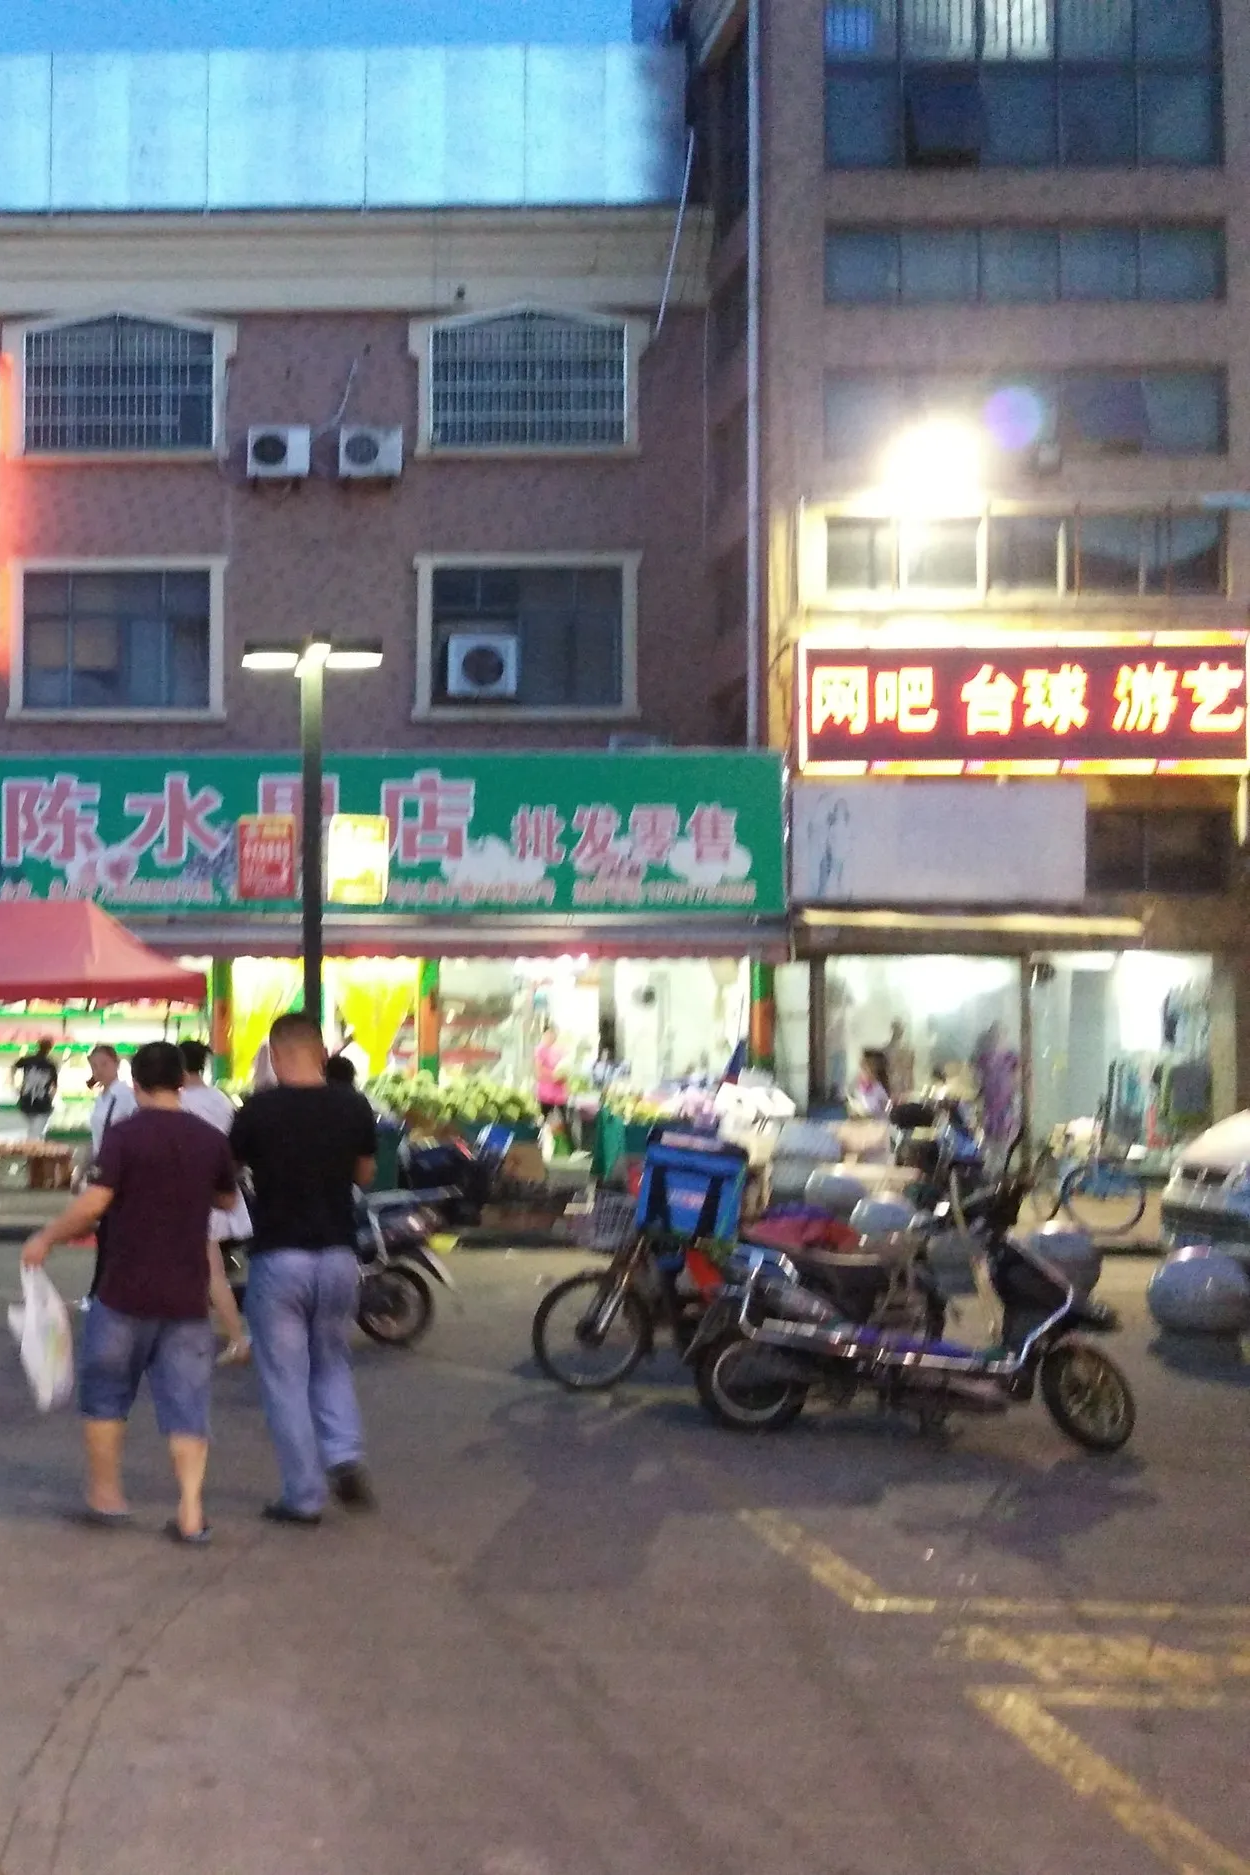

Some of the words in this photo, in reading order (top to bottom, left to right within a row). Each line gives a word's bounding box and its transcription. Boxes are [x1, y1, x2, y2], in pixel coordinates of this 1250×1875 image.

[810, 664, 940, 736] 网吧
[960, 662, 1091, 737] 台球
[1111, 660, 1245, 735] 游艺
[511, 801, 738, 866] 批发零售
